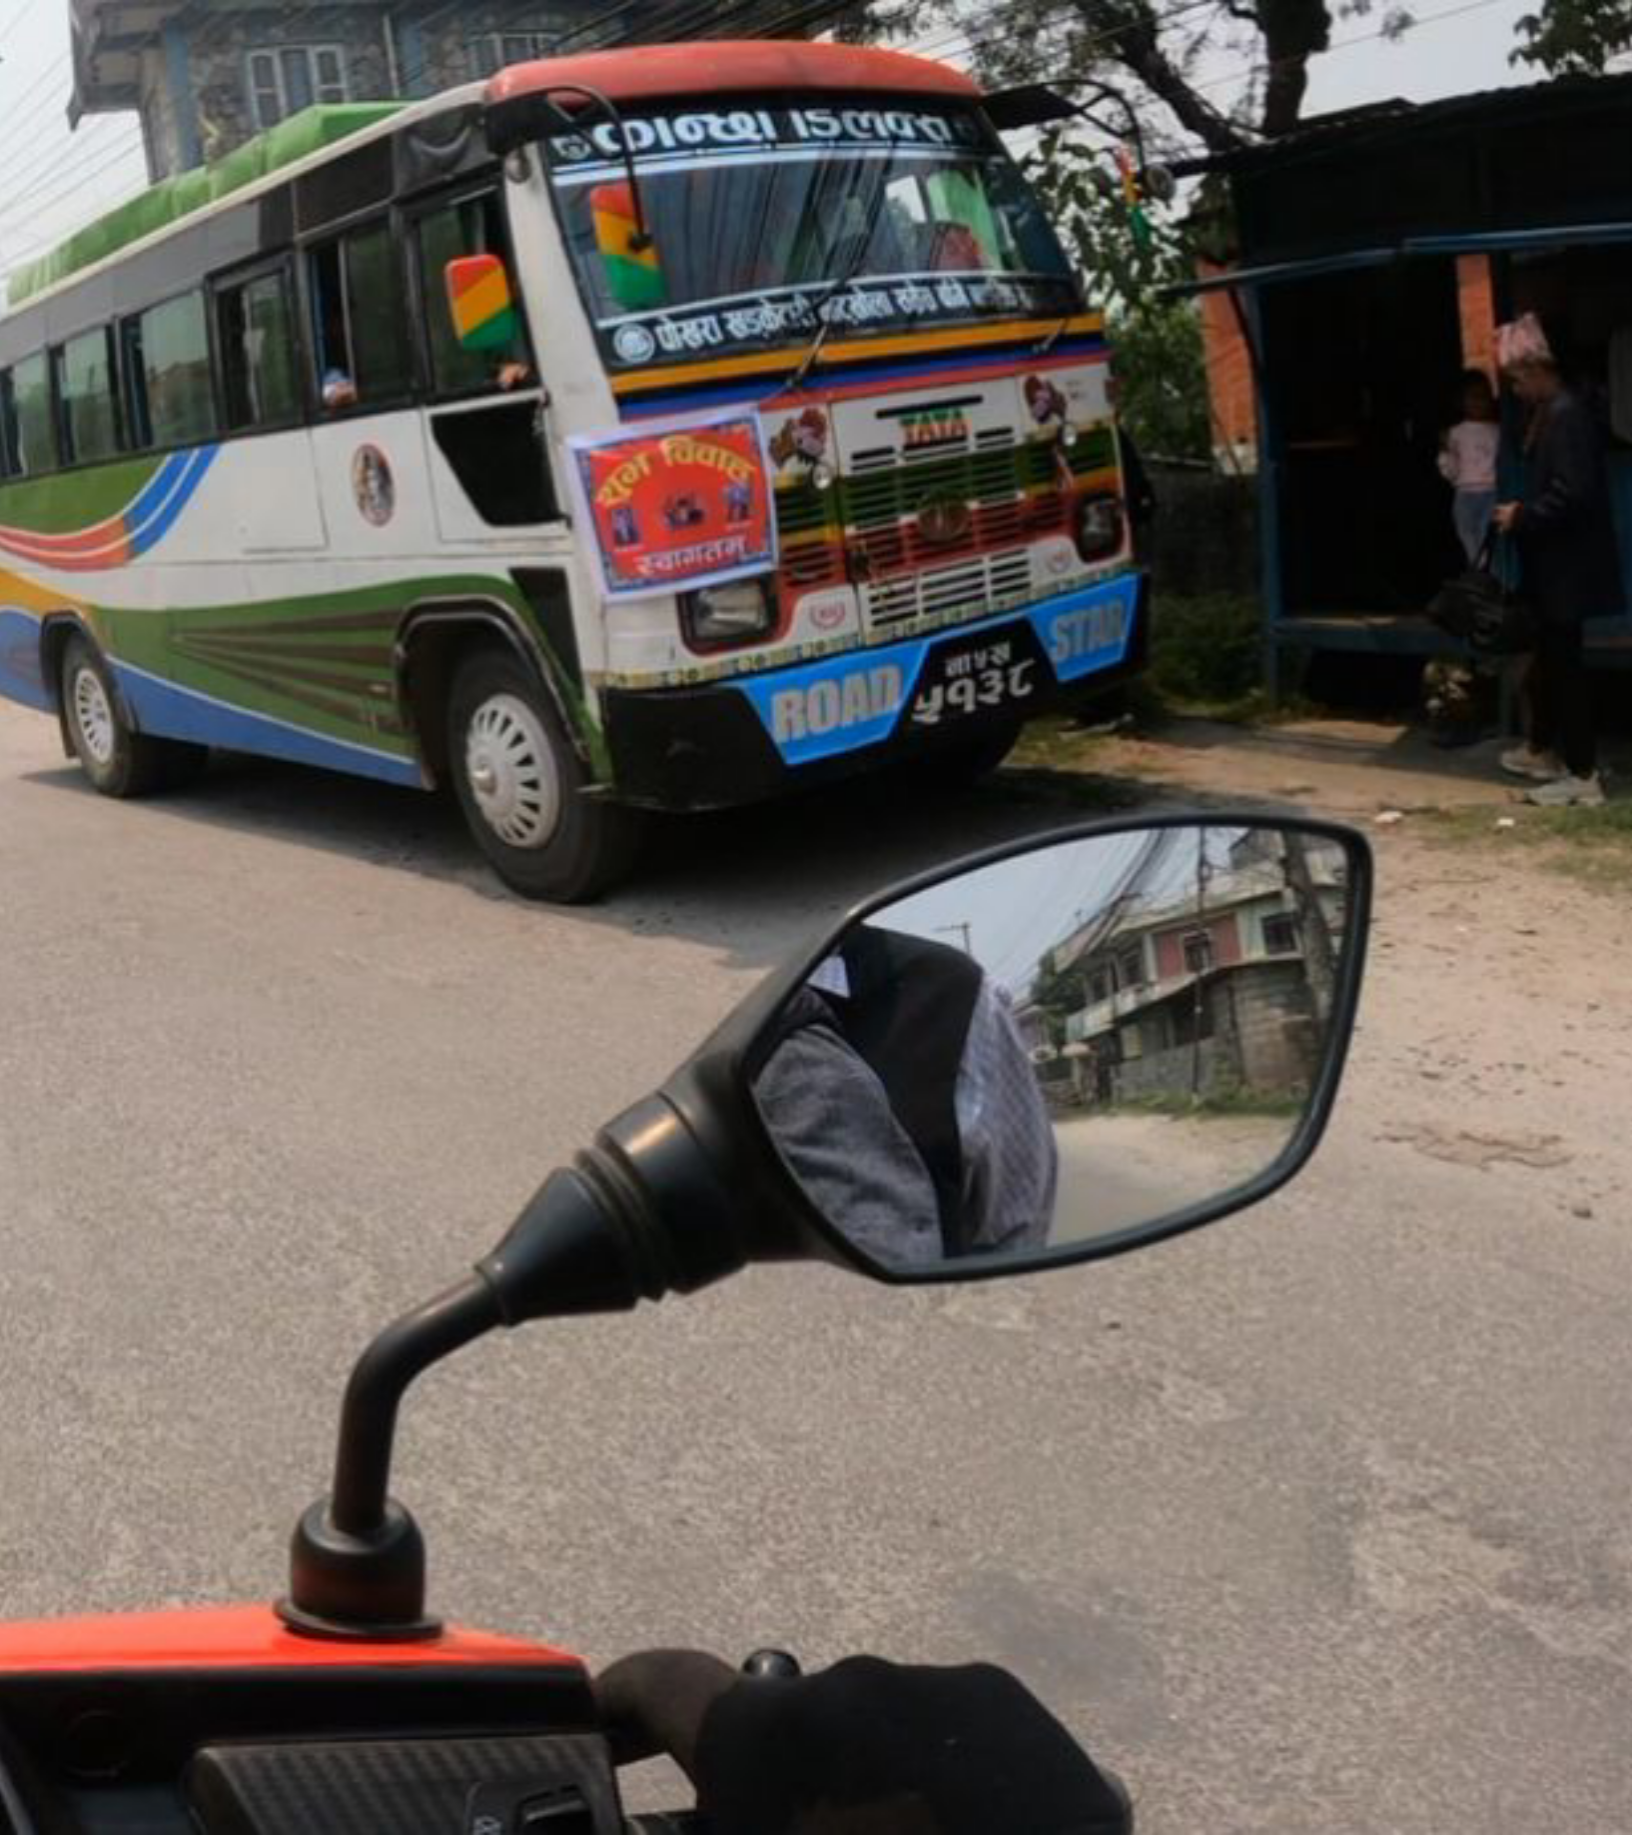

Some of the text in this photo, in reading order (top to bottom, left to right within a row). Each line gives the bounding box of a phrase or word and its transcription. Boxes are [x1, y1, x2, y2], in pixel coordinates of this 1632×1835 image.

[654, 313, 724, 351] पोखरा
[596, 433, 757, 508] शुभ विवाह
[770, 662, 904, 744] ROAD
